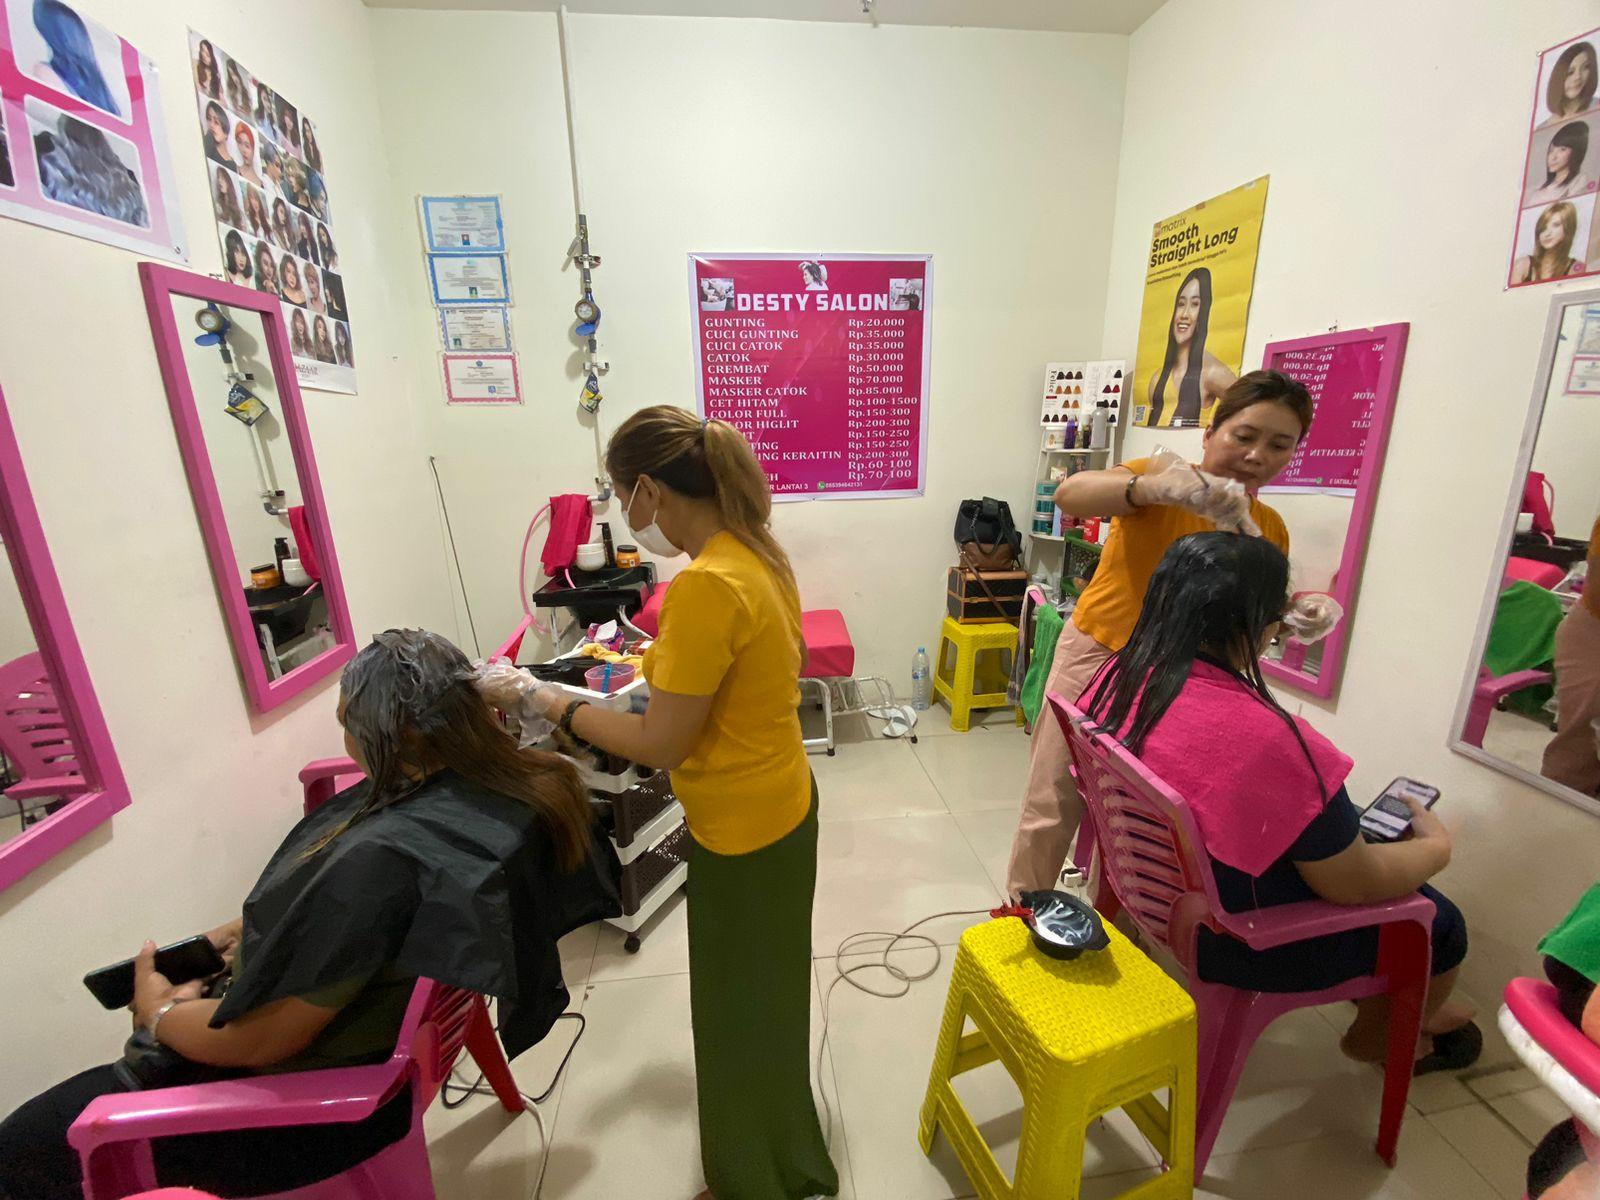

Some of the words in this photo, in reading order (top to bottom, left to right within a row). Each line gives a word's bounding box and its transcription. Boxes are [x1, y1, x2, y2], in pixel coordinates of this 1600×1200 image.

[1161, 217, 1186, 232] matrix
[1152, 223, 1199, 253] Smooth
[1150, 238, 1201, 267] Straight
[1204, 226, 1238, 249] Long
[737, 293, 809, 311] DESTY
[816, 293, 888, 311] SALON
[705, 318, 765, 327] GUNTING
[848, 318, 905, 328] Rp.20.000
[705, 330, 735, 339] CUCI
[739, 330, 798, 339] GUNTING
[848, 330, 904, 340] Rp.35.000
[706, 342, 736, 350] CUCI
[740, 341, 783, 350] CATOK
[848, 342, 904, 351] Rp.35.000
[707, 353, 750, 362] CATOK
[848, 353, 904, 363] Rp.30.000
[707, 365, 769, 374] CREMBAT
[848, 365, 903, 374] Rp.50.000
[708, 376, 762, 385] MASKER
[848, 376, 903, 385] Rp.70.000
[709, 388, 762, 396] MASKER
[765, 387, 807, 396] CATOK
[848, 387, 902, 396] Rp.85.000
[710, 399, 733, 408] CET
[737, 399, 778, 407] HITAM
[848, 397, 917, 407] Rp.100-1500
[710, 410, 752, 419] COLOR
[756, 410, 787, 418] FULL
[848, 408, 910, 418] Rp.150-300
[756, 420, 799, 429] HIGLIT
[848, 419, 910, 429] Rp.200-300
[848, 430, 909, 439] Rp.150-250
[848, 440, 909, 450] Rp.150-250
[783, 451, 841, 460] KERAITIN
[848, 450, 909, 460] Rp.200-300
[848, 460, 912, 470] Rp.60-100
[848, 470, 911, 480] Rp.70-100
